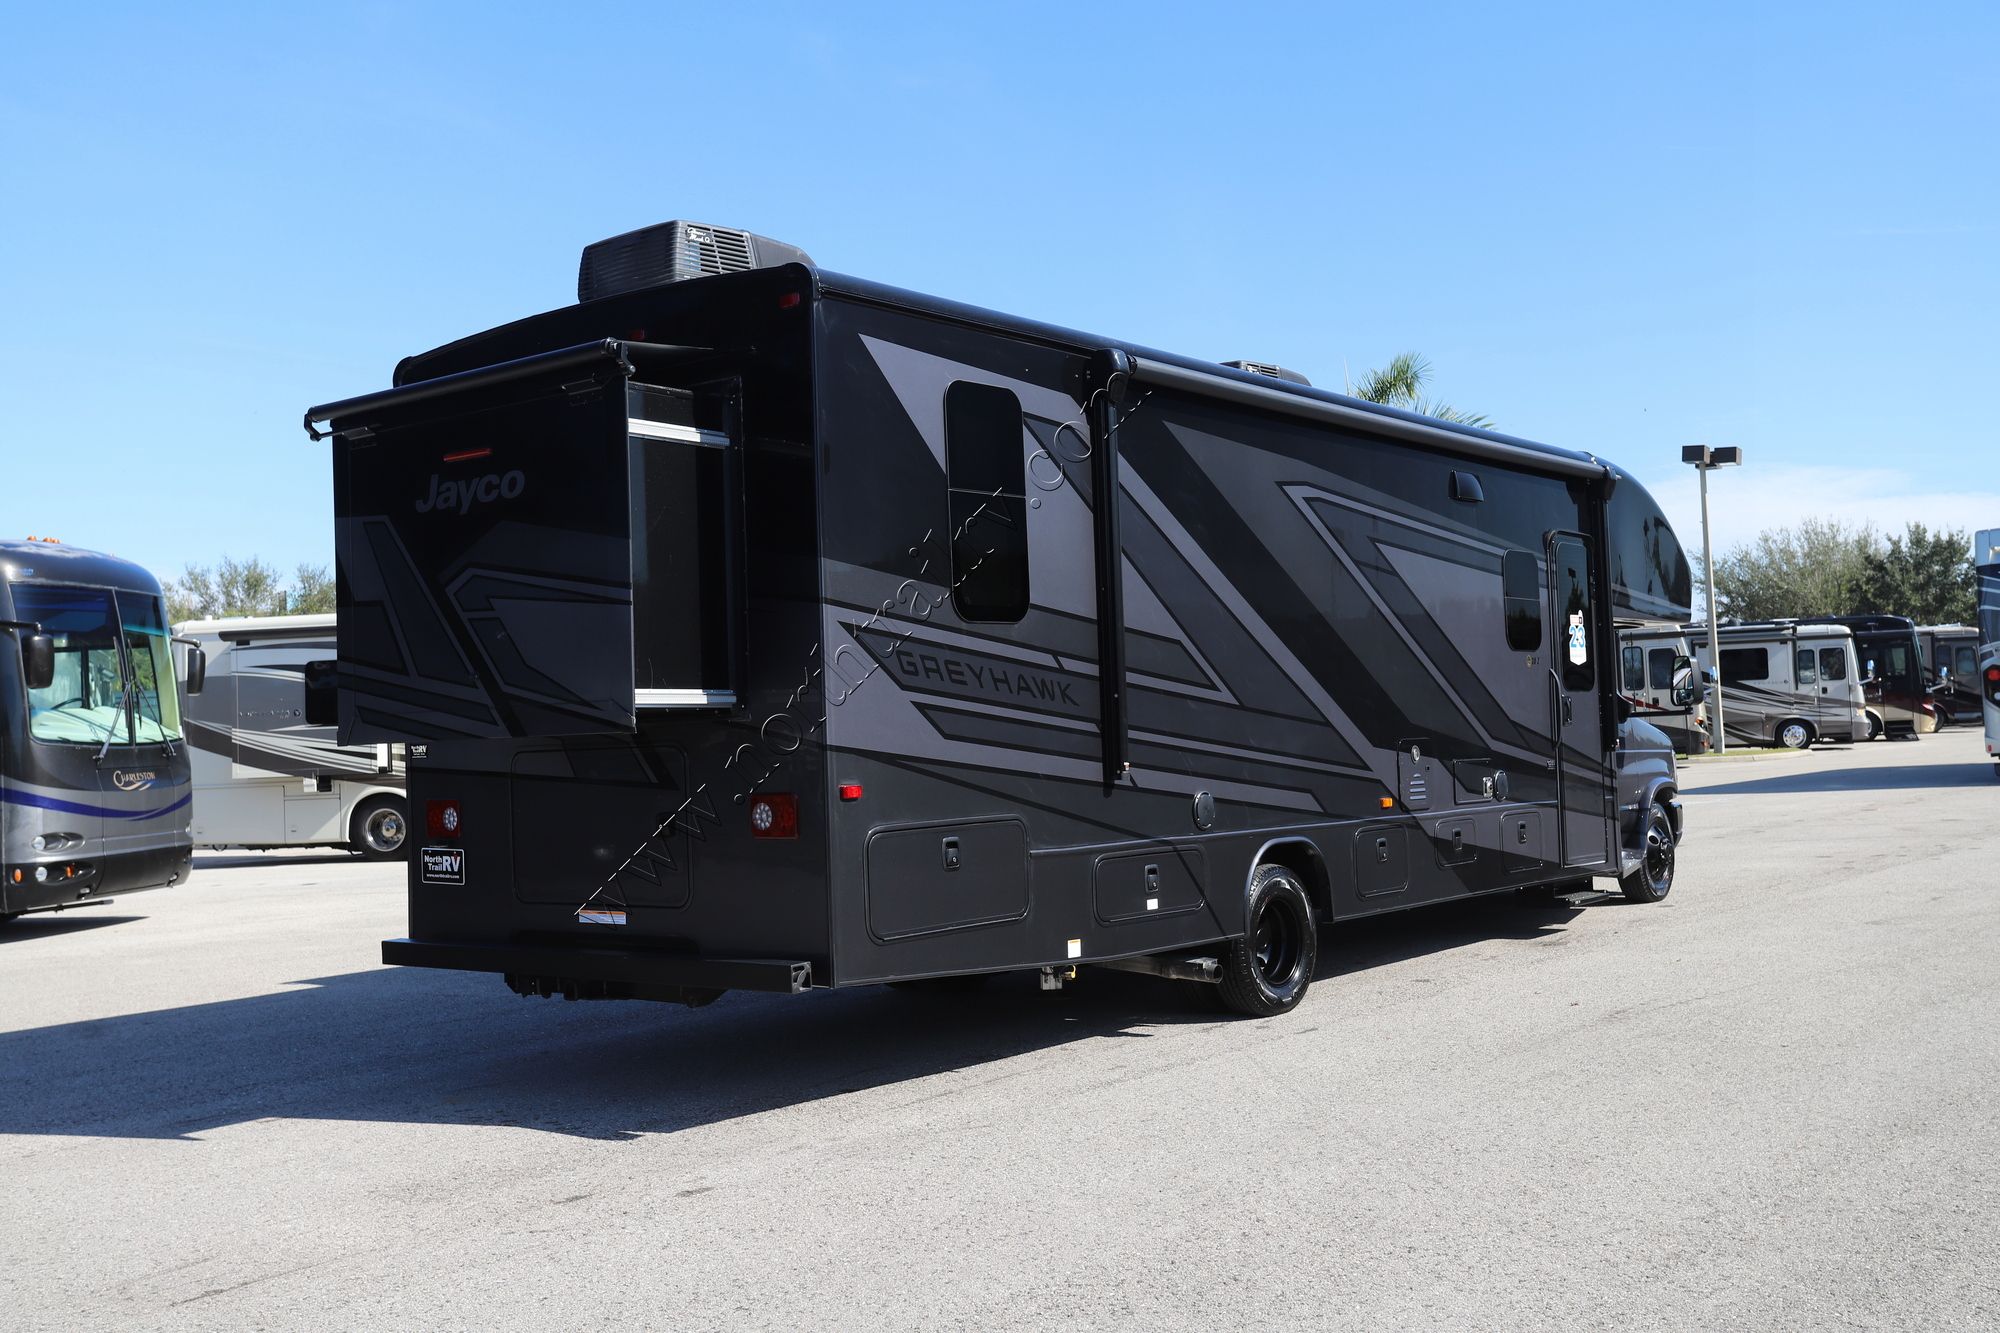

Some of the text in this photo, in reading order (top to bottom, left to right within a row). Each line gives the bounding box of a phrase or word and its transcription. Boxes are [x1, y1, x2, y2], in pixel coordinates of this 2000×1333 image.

[416, 470, 525, 515] Jayco
[897, 650, 1080, 707] GREYHAWK
[424, 855, 460, 872] North RV
[428, 863, 442, 871] Trail
